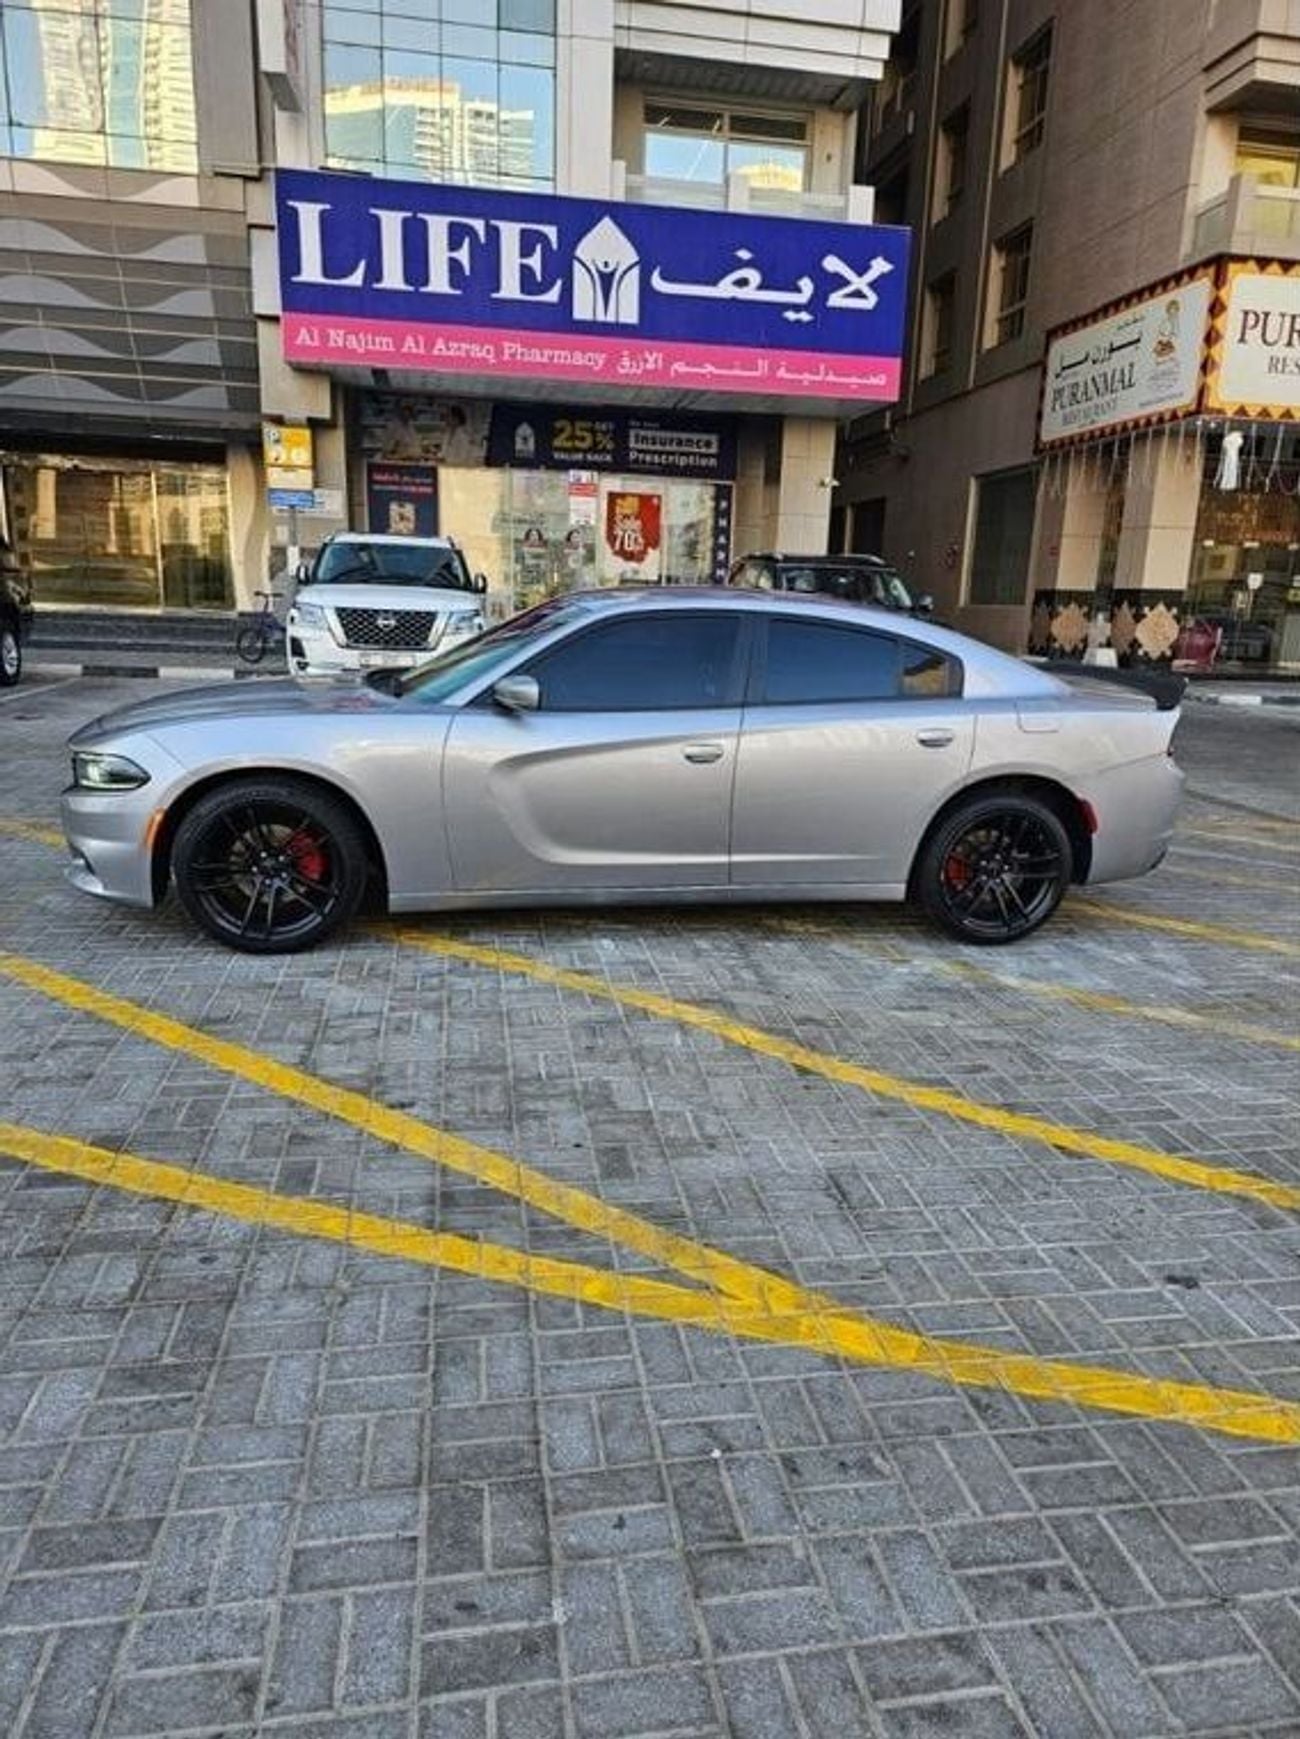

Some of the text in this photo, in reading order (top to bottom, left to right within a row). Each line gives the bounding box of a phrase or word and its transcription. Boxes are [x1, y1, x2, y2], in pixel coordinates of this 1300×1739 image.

[286, 200, 562, 303] LIFE
[651, 248, 894, 322] لايف
[295, 327, 607, 371] Al Najim Al Azraq Pharmacy
[670, 358, 768, 378] النجم
[775, 362, 887, 387] صيدلية
[1050, 362, 1136, 412] PURANMAL
[633, 432, 713, 450] Insurance
[629, 451, 718, 468] Prescription
